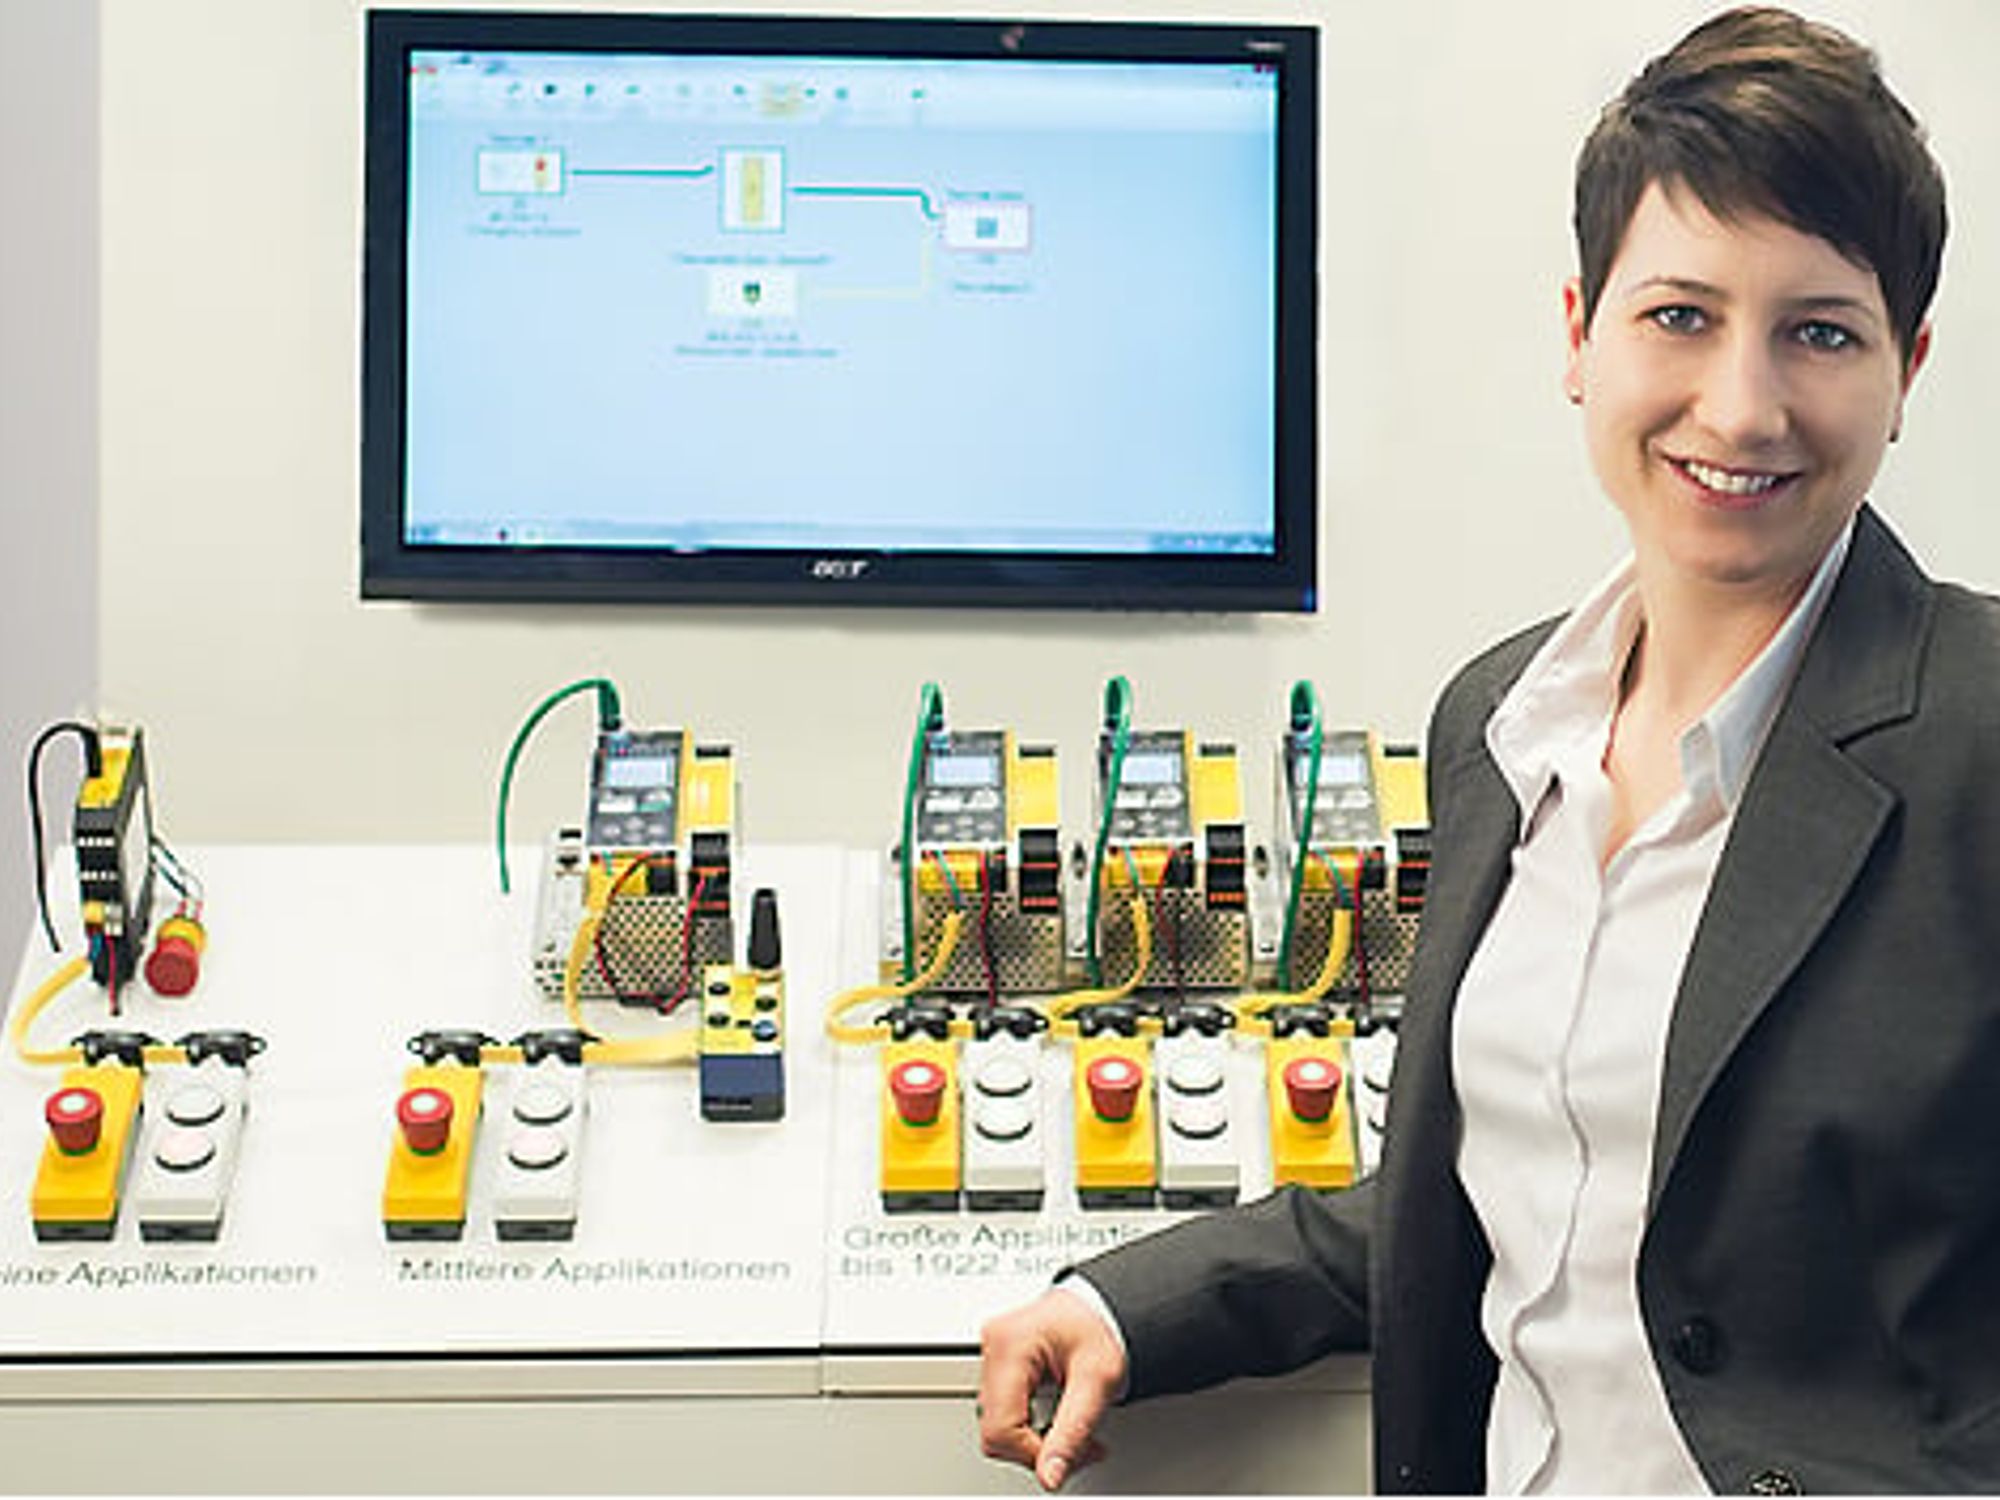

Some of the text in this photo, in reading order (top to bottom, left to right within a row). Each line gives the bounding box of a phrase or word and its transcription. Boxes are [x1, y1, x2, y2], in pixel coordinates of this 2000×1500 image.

[844, 1224, 960, 1250] Große
[66, 1261, 317, 1288] Applikationen
[399, 1257, 791, 1285] Mittlere Applikationen
[842, 1254, 893, 1276] bis
[913, 1253, 999, 1277] 1922
